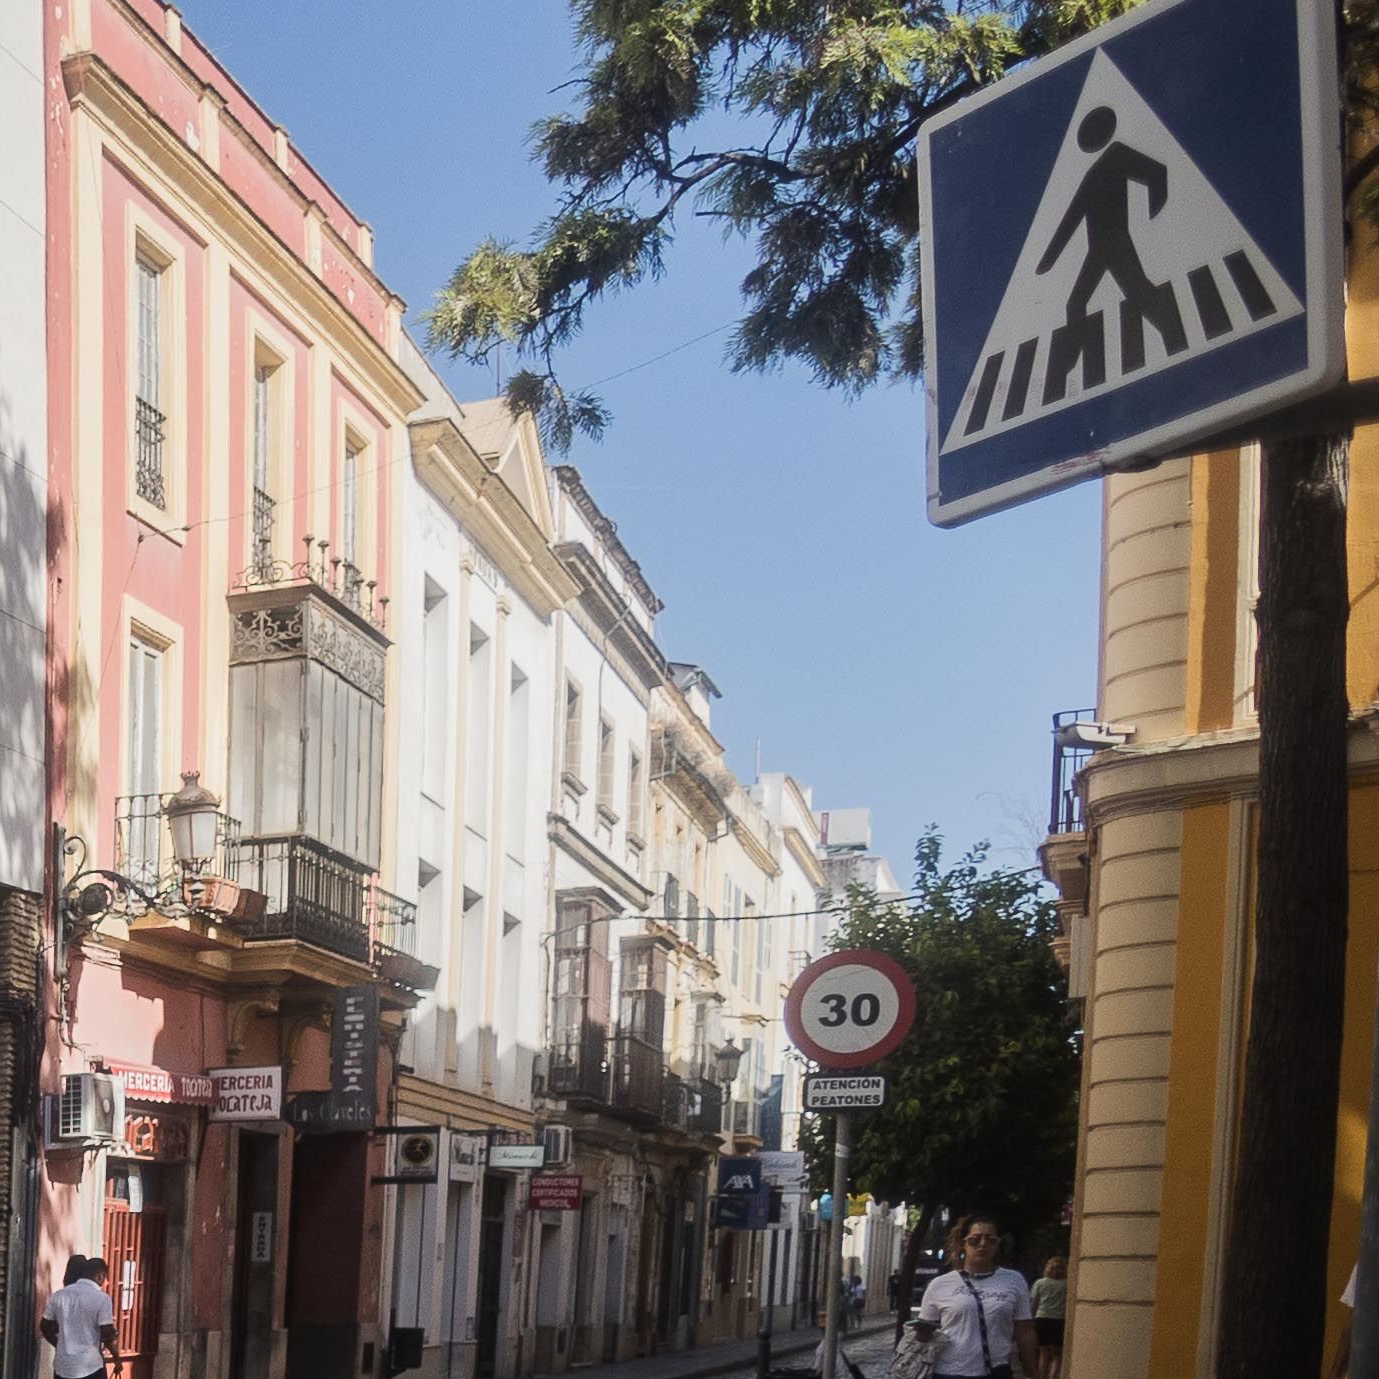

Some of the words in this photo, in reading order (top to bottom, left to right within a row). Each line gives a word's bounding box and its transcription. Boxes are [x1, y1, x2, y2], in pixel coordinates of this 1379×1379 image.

[818, 993, 881, 1028] 30
[118, 1071, 175, 1093] MERCERIA
[219, 1075, 273, 1091] ERCERIA
[813, 1078, 880, 1090] ATENCIÓN
[811, 1095, 880, 1106] PEATONES
[723, 1175, 754, 1189] AXA
